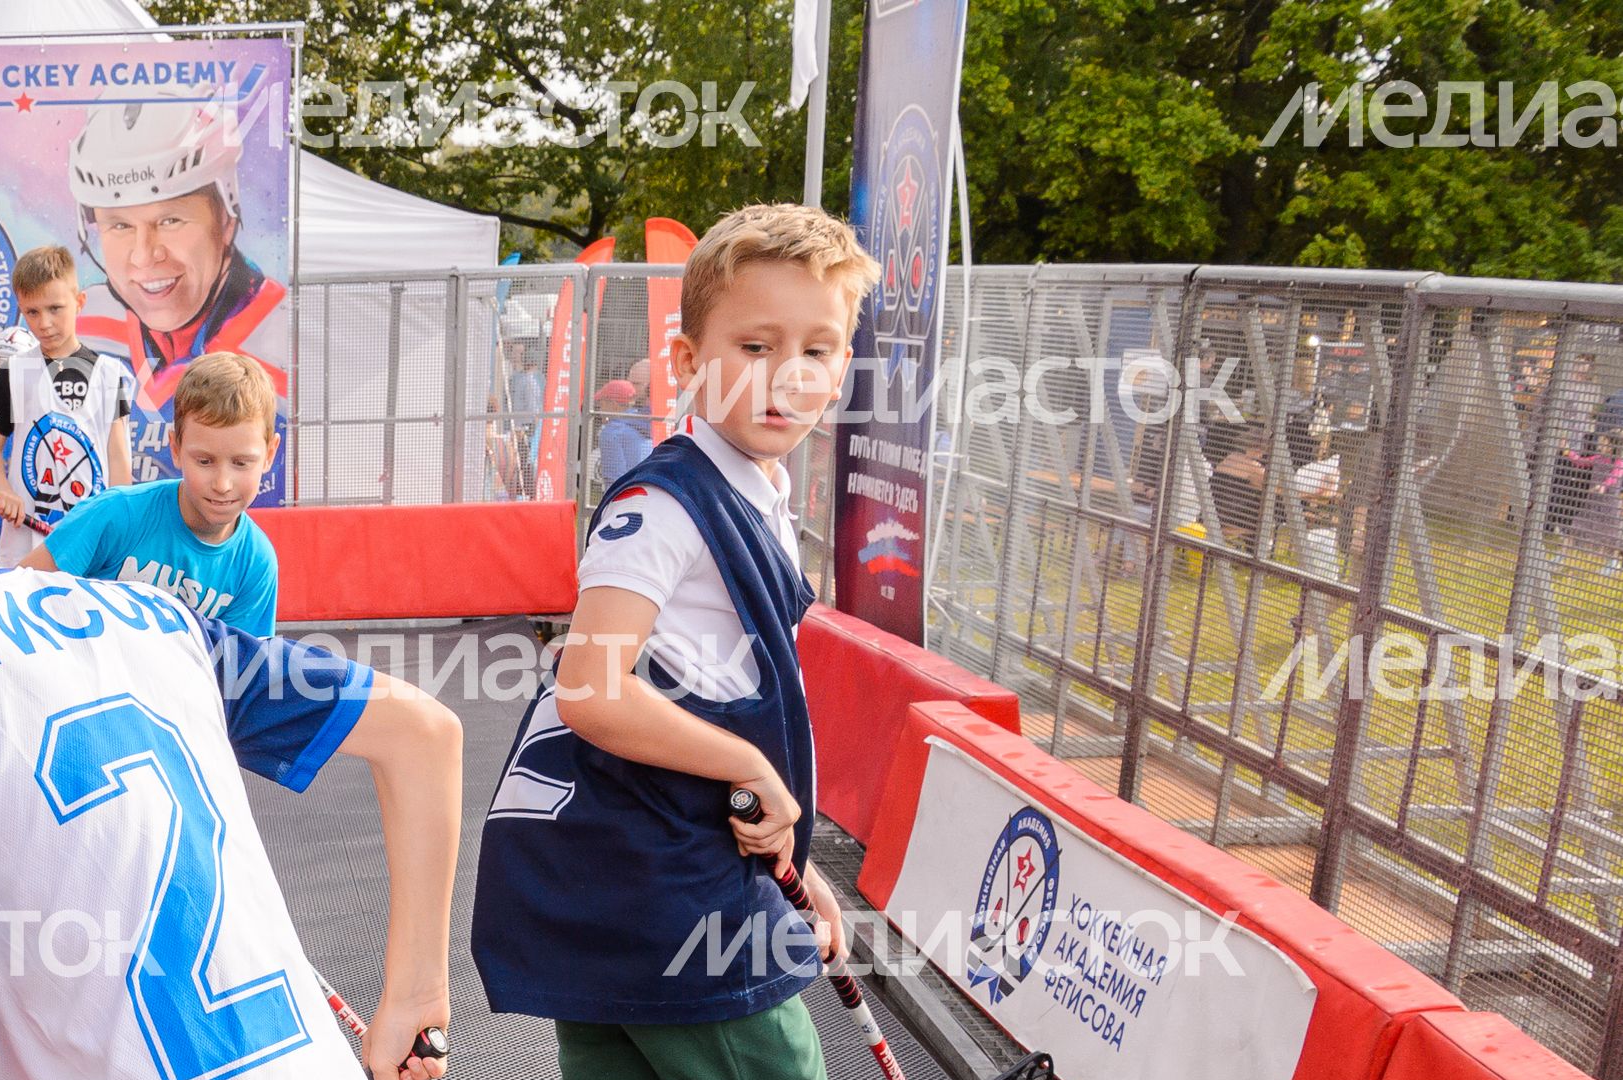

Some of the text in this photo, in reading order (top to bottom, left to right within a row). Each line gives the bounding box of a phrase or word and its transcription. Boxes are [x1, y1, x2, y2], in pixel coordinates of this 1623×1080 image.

[89, 60, 238, 86] ACADEMY
[107, 164, 156, 187] Reebok
[1017, 817, 1052, 850] АКАДЕМИЯ
[1018, 859, 1031, 884] 2
[1065, 892, 1169, 986] ХОККЕЙНАЯ
[1053, 931, 1147, 1019] АКАДЕМИЯ
[1044, 968, 1126, 1053] ФЕТИСОВА
